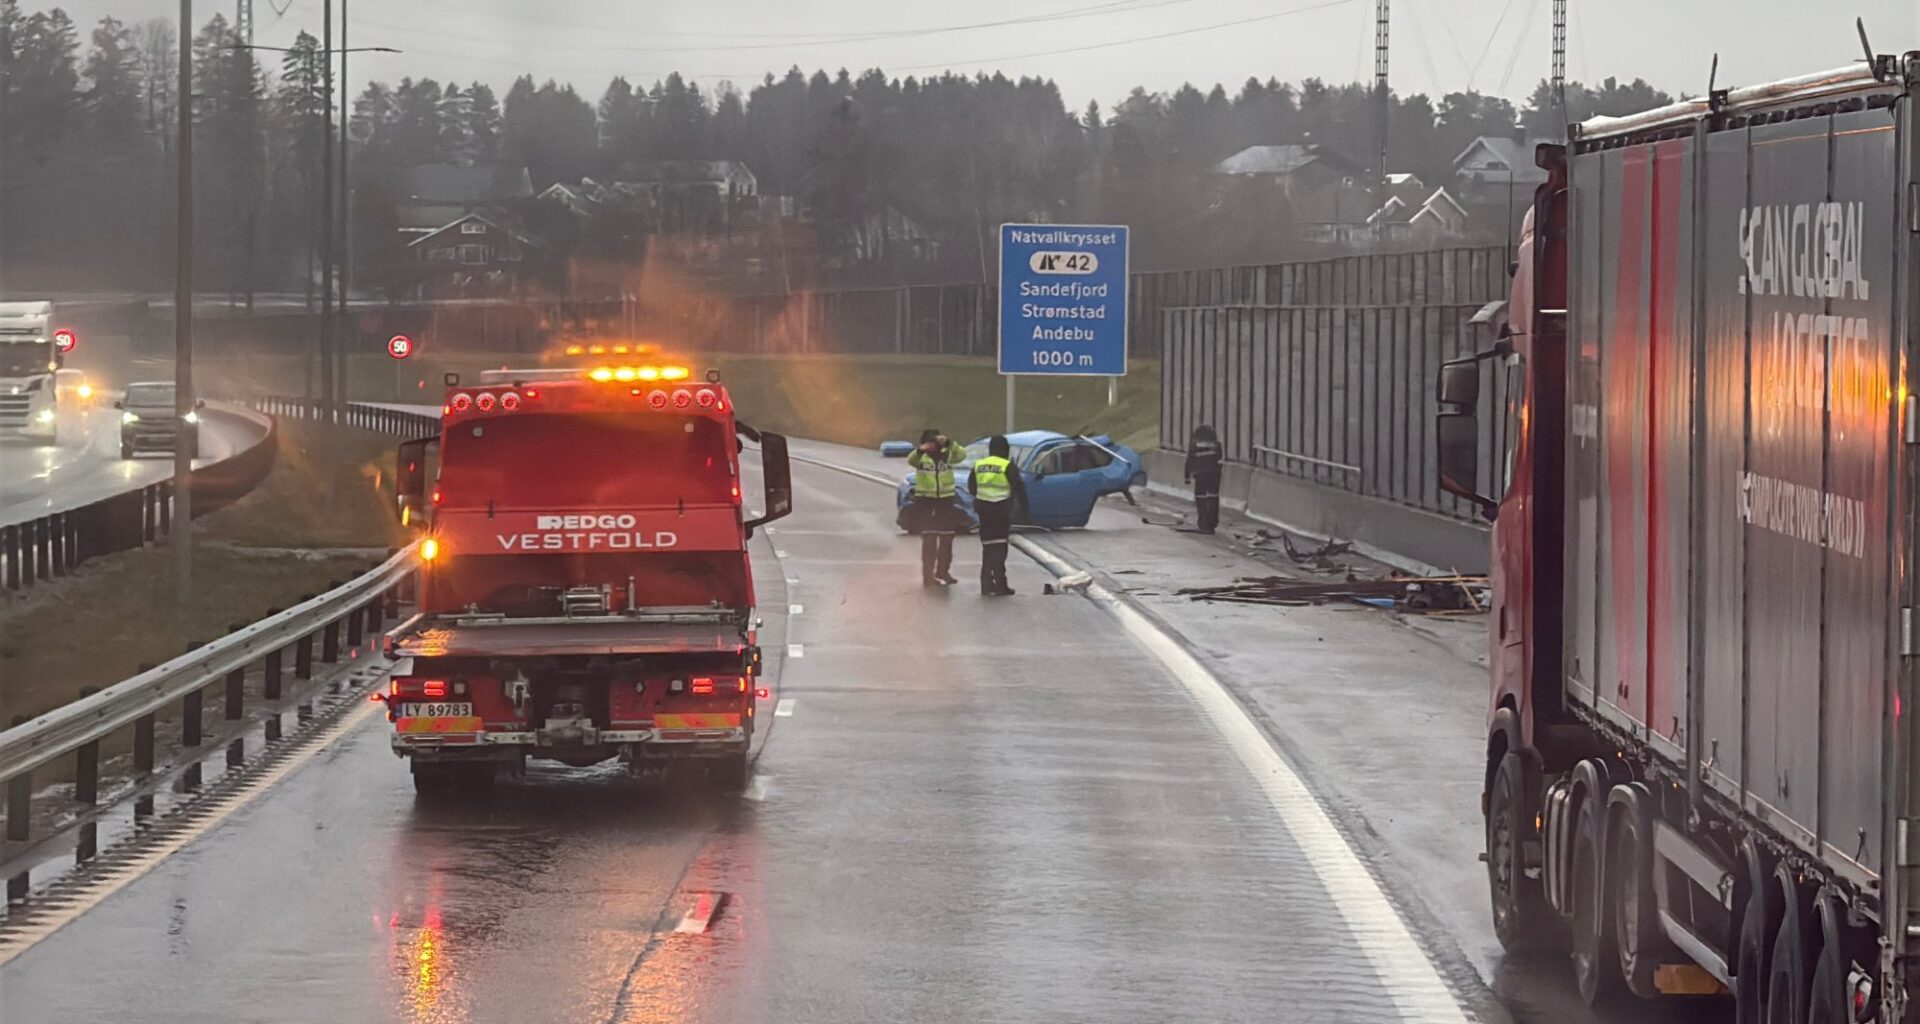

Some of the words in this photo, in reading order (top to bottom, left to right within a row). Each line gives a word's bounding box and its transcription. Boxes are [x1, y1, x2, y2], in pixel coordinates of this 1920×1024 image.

[1011, 230, 1116, 246] Natvallkrysset
[1738, 204, 1789, 297] SCAN
[1791, 201, 1869, 300] GLOBAL
[1066, 255, 1090, 271] 42
[1020, 281, 1108, 300] Sandefjord
[1022, 303, 1105, 319] Strømstad
[56, 334, 71, 346] 50
[1032, 325, 1094, 340] Andebu
[394, 340, 407, 352] 50
[1032, 351, 1073, 366] 1000
[1079, 355, 1093, 366] m
[537, 514, 636, 530] REDGO
[497, 532, 677, 550] VESTFOLD
[406, 704, 421, 717] LY
[428, 704, 469, 717] 89783
